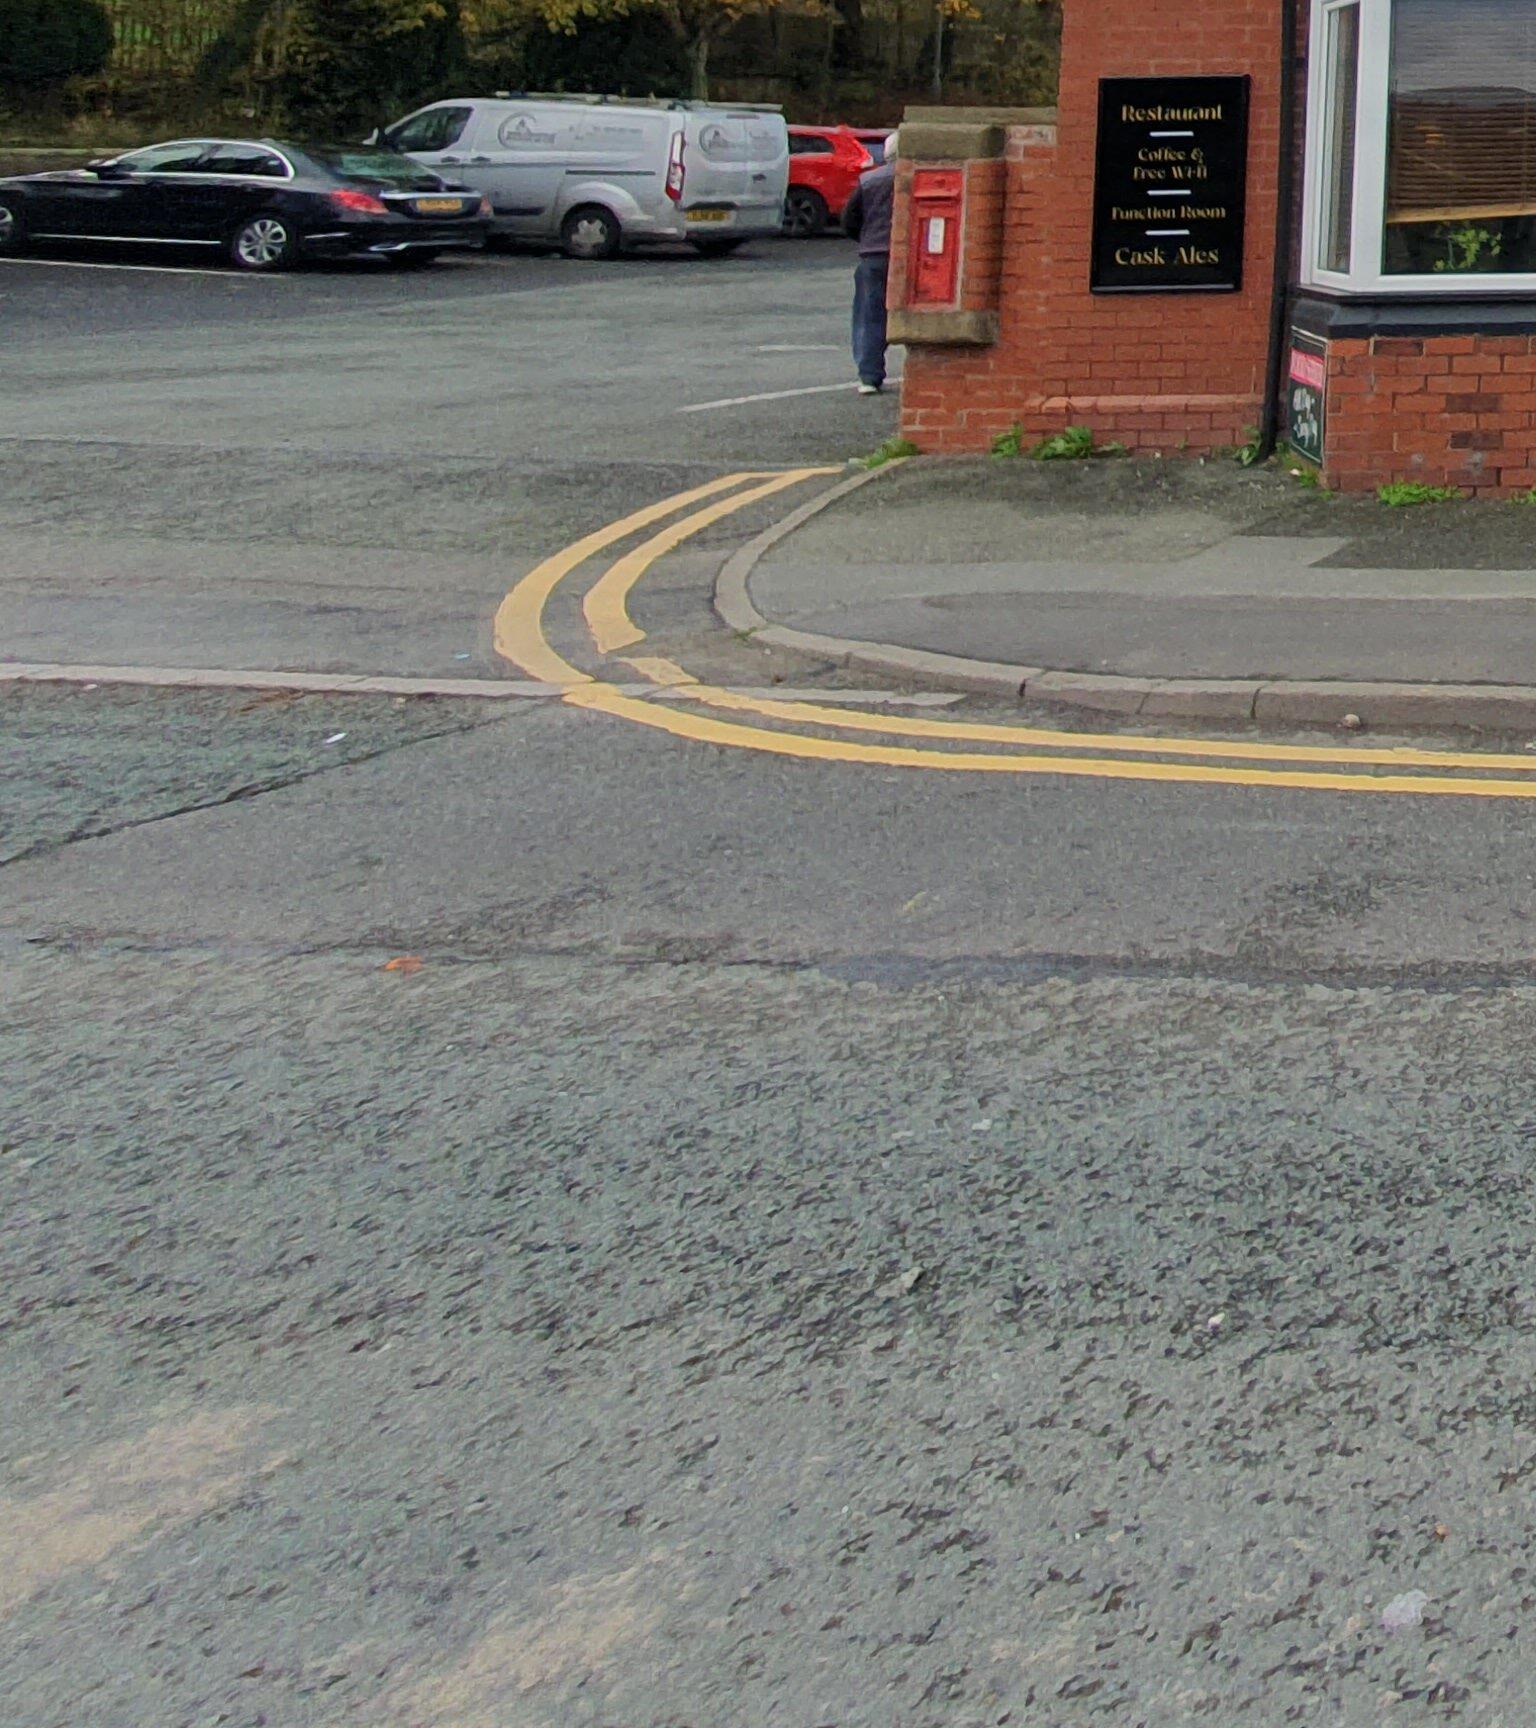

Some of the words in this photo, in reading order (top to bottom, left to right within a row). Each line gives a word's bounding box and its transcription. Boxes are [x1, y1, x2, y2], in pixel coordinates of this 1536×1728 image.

[1121, 103, 1223, 122] Restaurant
[1137, 148, 1187, 163] Coffee
[1191, 147, 1205, 165] &
[1132, 165, 1167, 181] Free
[1111, 206, 1176, 221] Function
[1180, 205, 1227, 219] Room
[1114, 246, 1166, 266] Cask
[1175, 245, 1220, 264] Ales
